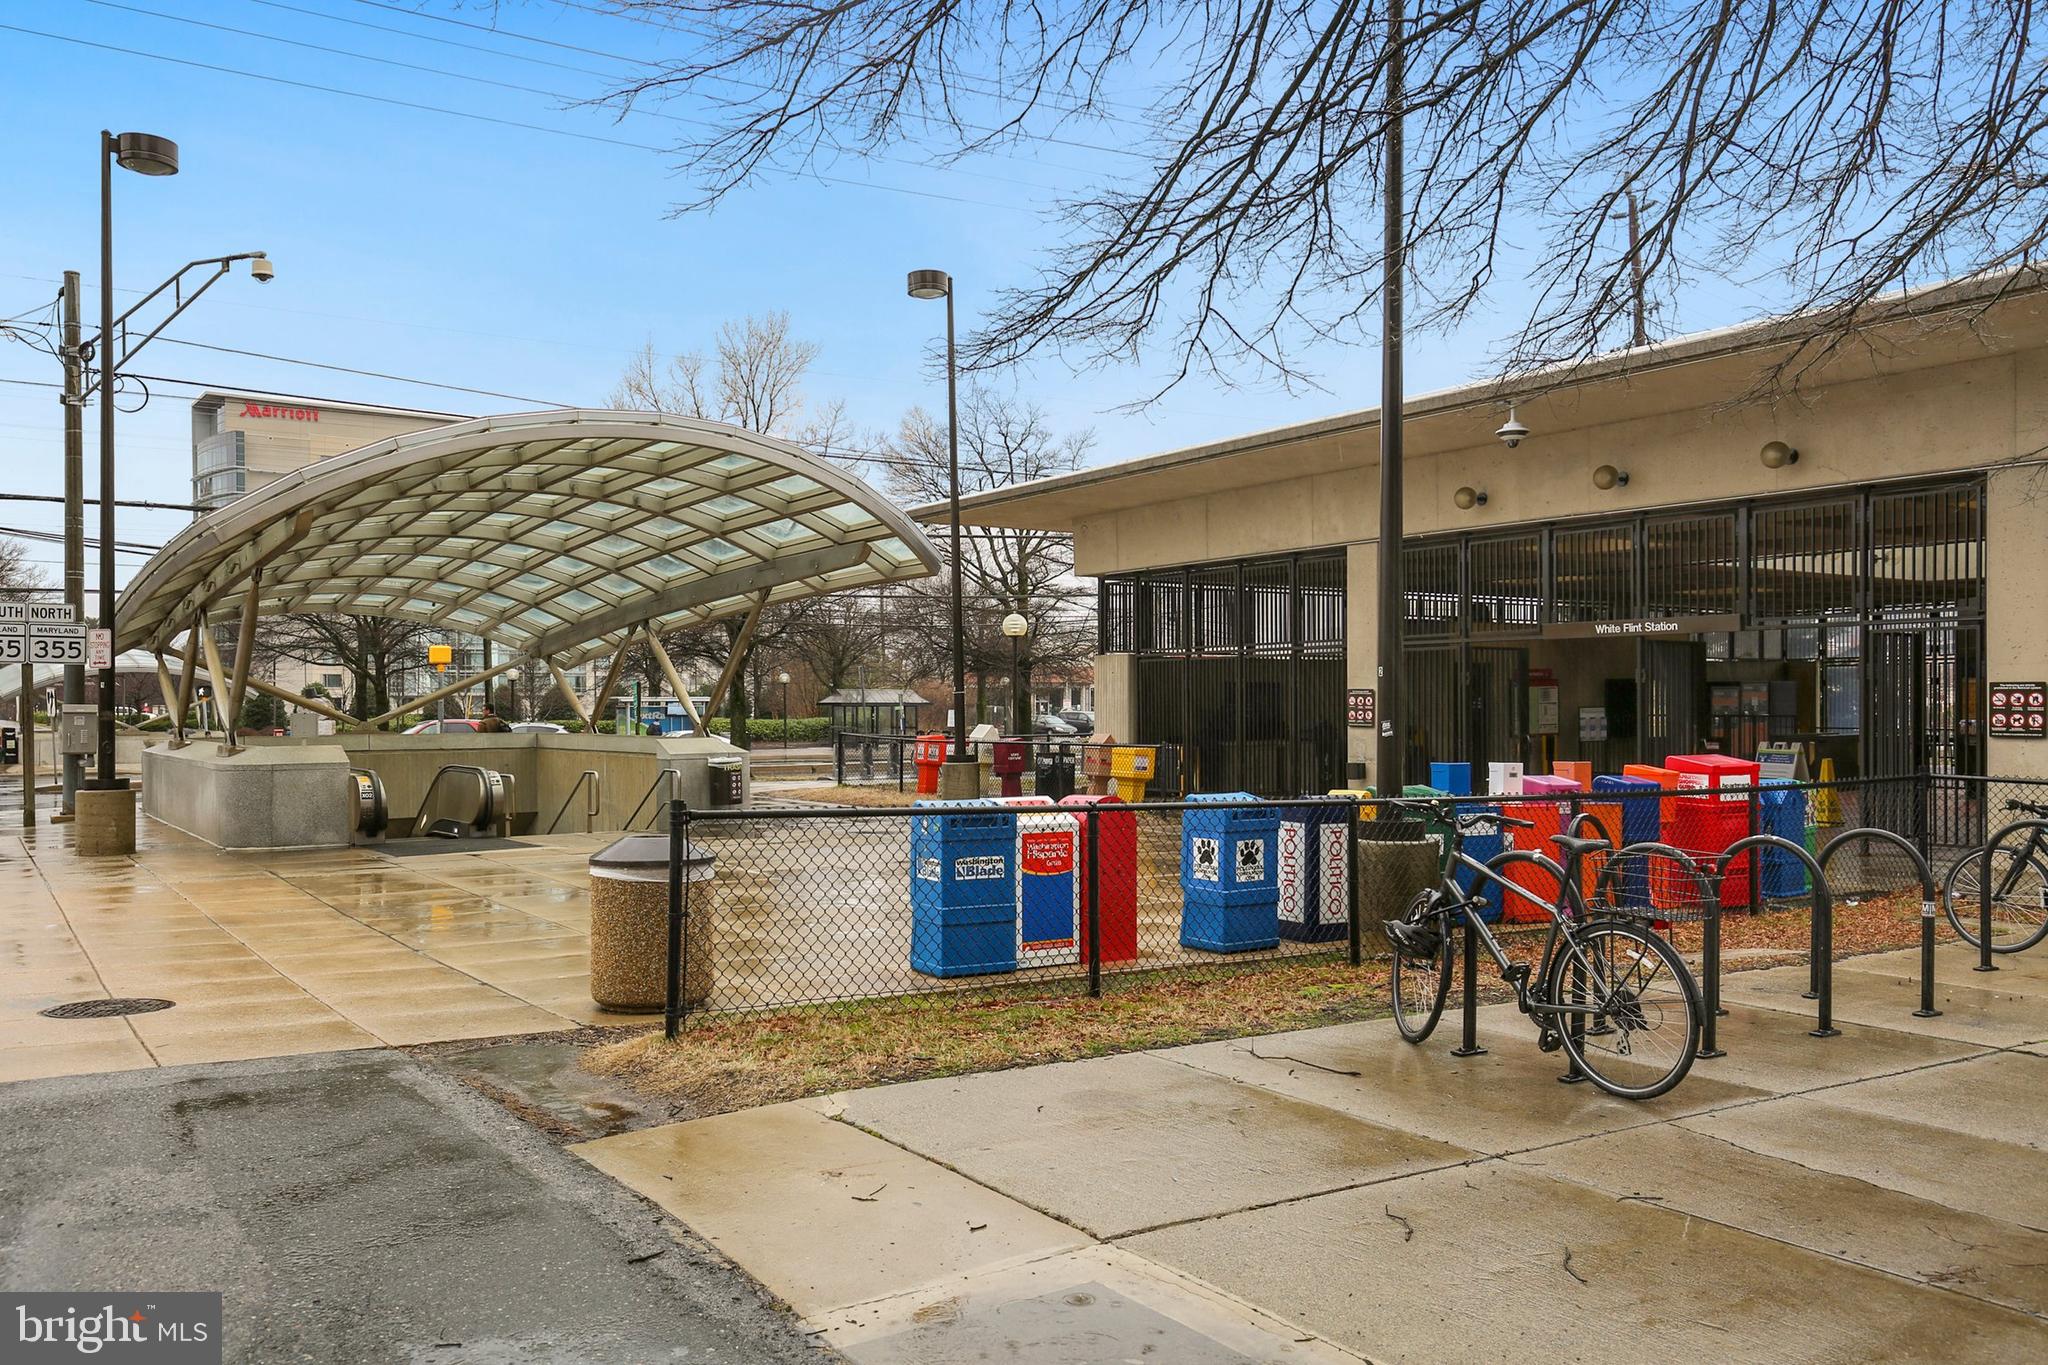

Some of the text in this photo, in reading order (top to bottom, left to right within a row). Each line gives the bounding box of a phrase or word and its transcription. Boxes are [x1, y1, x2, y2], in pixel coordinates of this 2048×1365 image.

[240, 402, 319, 422] Marriott
[31, 607, 72, 619] NORTH
[37, 626, 79, 635] MARYLAND
[1595, 621, 1678, 634] White Flint Station
[95, 632, 105, 640] NO
[33, 640, 82, 659] 355
[1027, 849, 1068, 860] Hispanic
[966, 865, 1004, 877] Blade
[1284, 828, 1298, 913] POLITICO
[1328, 828, 1344, 915] POLITICO
